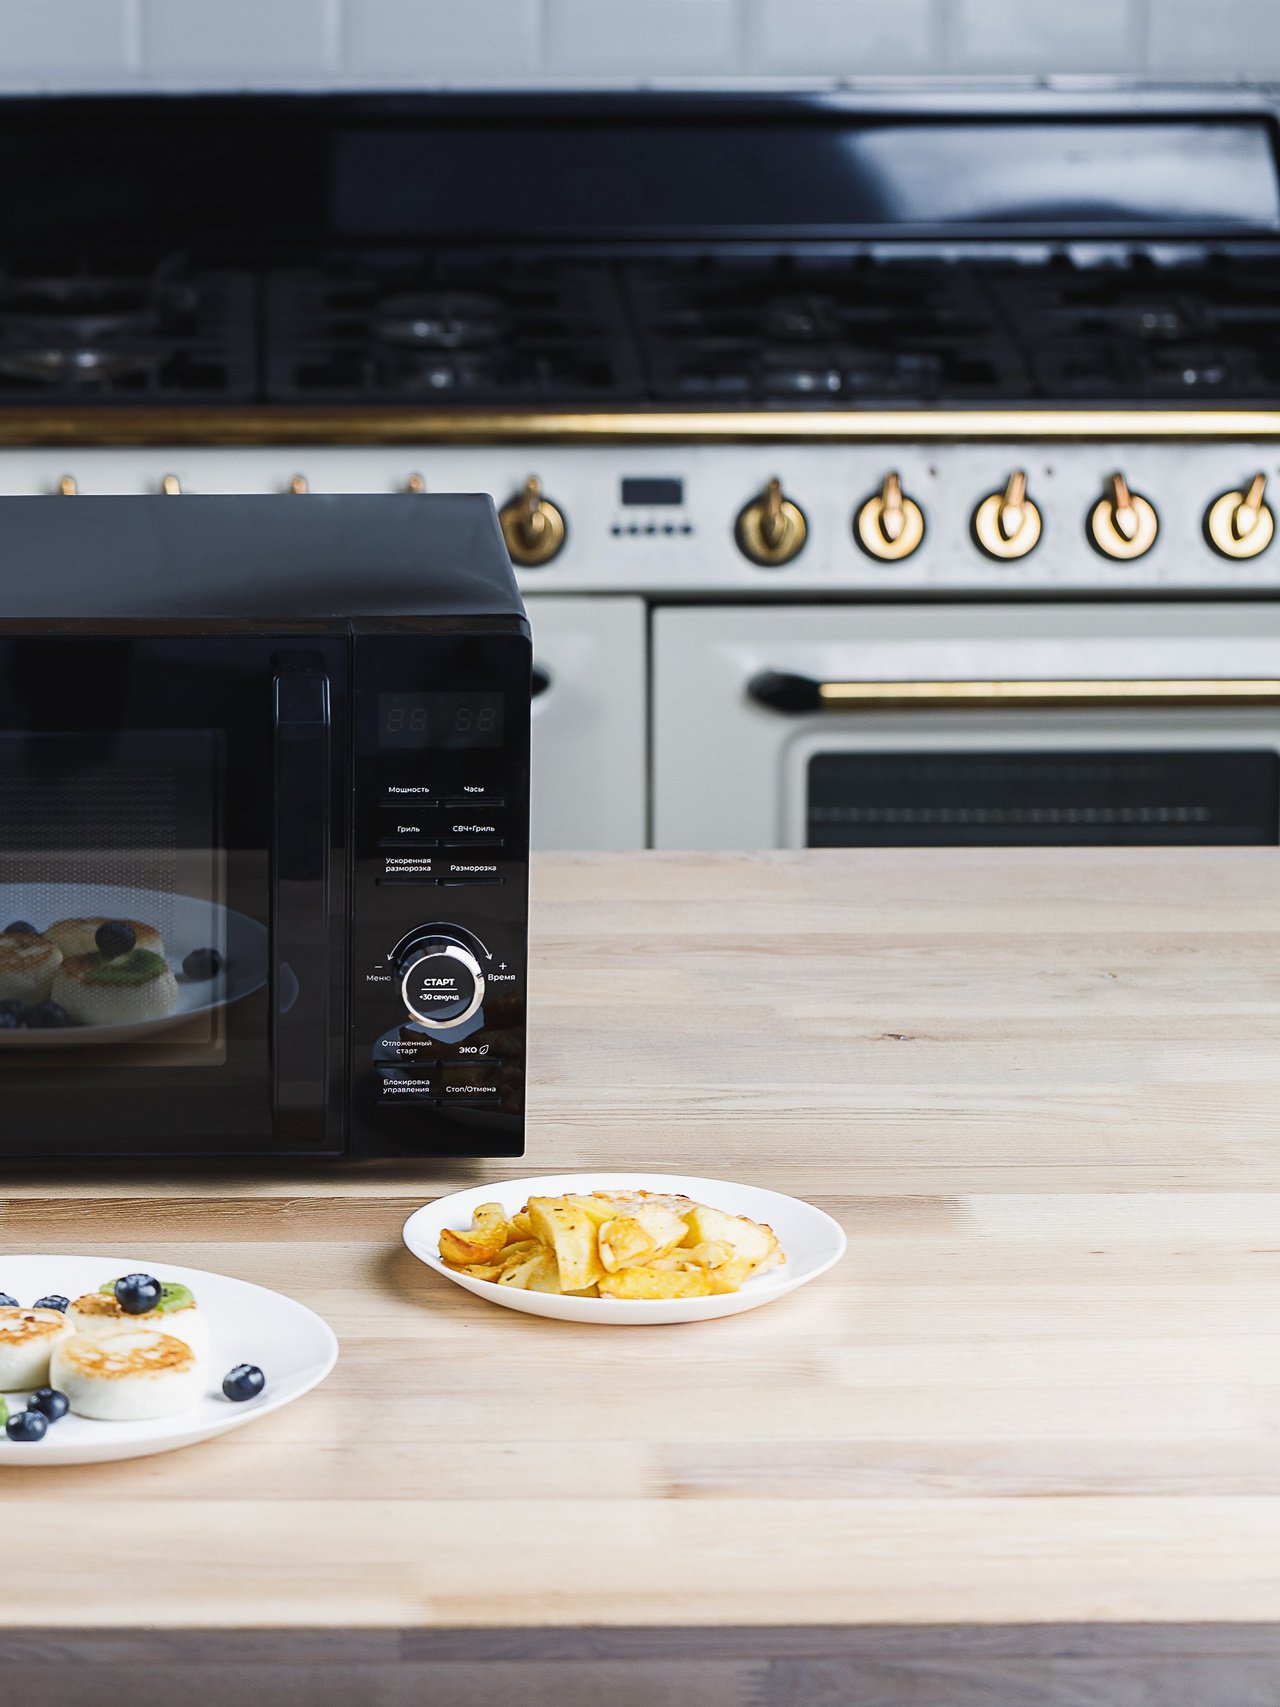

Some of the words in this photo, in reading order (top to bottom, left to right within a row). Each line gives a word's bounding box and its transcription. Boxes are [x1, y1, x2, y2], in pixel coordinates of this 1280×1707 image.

[397, 825, 421, 833] Гриль
[452, 825, 496, 833] СВЧ+Гриль
[385, 857, 432, 865] Ускоренная
[385, 865, 432, 873] разморозка
[450, 864, 497, 872] Разморозка
[366, 974, 392, 982] Меню
[487, 973, 516, 982] Время
[423, 978, 456, 986] СТАРТ
[419, 993, 433, 1001] +30
[433, 993, 460, 1001] секунд
[381, 1039, 433, 1048] Отложенный
[458, 1046, 478, 1054] ЭКО
[382, 1086, 430, 1094] управления
[445, 1085, 497, 1094] Стоп/Отмена
